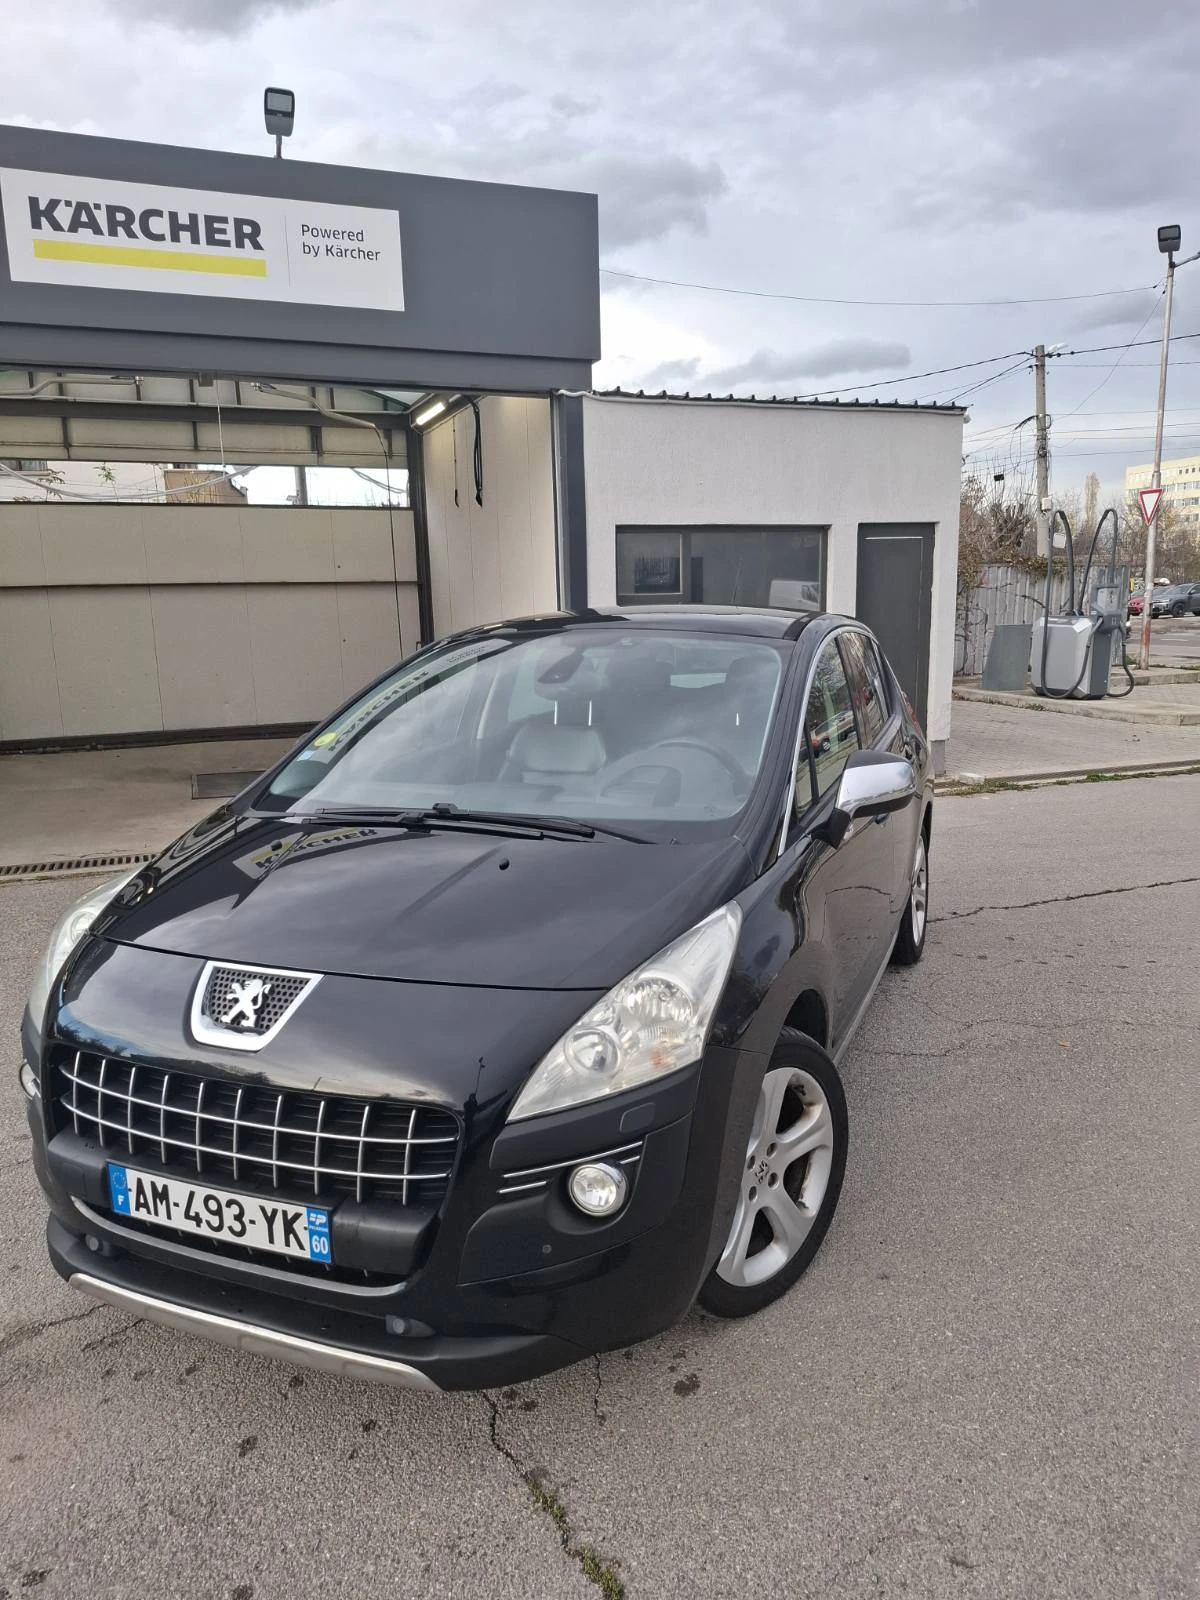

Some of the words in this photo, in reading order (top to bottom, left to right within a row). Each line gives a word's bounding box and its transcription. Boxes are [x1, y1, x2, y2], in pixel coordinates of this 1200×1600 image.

[28, 195, 264, 251] KÄRCHER
[301, 224, 365, 242] Powered
[302, 241, 320, 258] by
[325, 244, 381, 261] Kärcher
[117, 1194, 124, 1206] F
[134, 1177, 306, 1251] AM-493-YK
[312, 1235, 329, 1254] 60
